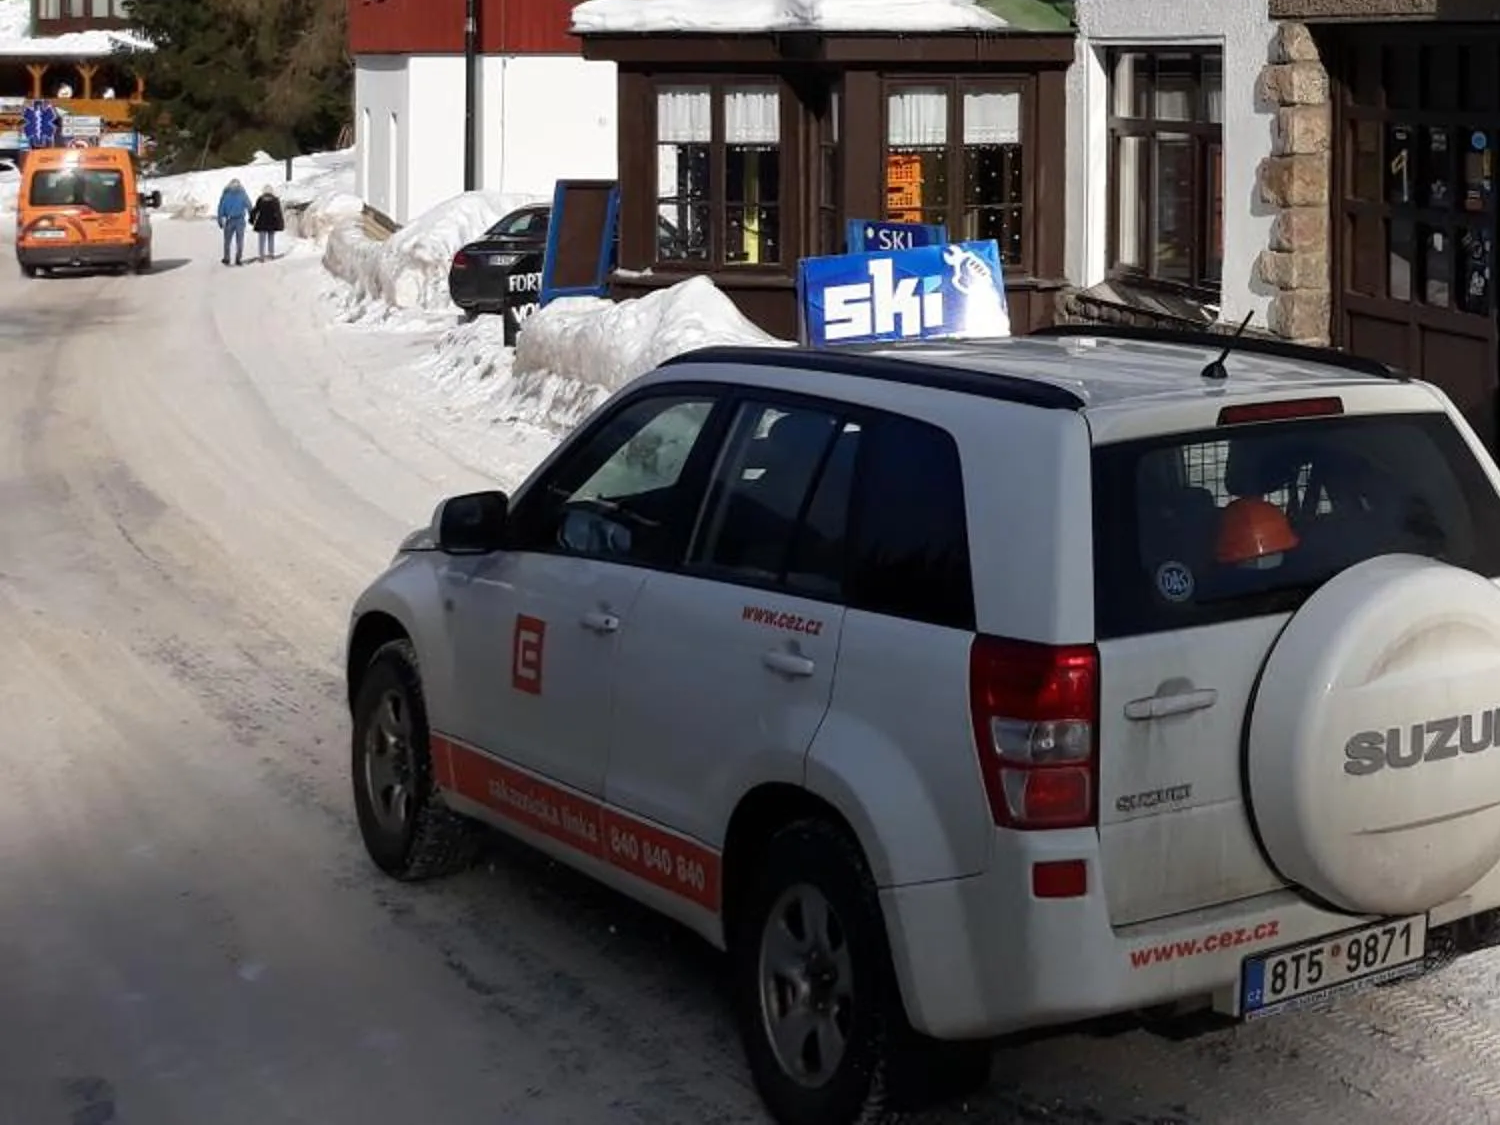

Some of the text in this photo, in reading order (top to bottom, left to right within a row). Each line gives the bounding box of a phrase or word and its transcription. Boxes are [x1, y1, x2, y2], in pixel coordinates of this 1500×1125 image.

[879, 229, 913, 252] SKI
[822, 258, 944, 341] ski
[741, 602, 823, 636] www.cez.cz
[609, 825, 640, 862] 840
[1130, 920, 1280, 970] www.cez.cz
[1270, 921, 1411, 996] 8T5 9871
